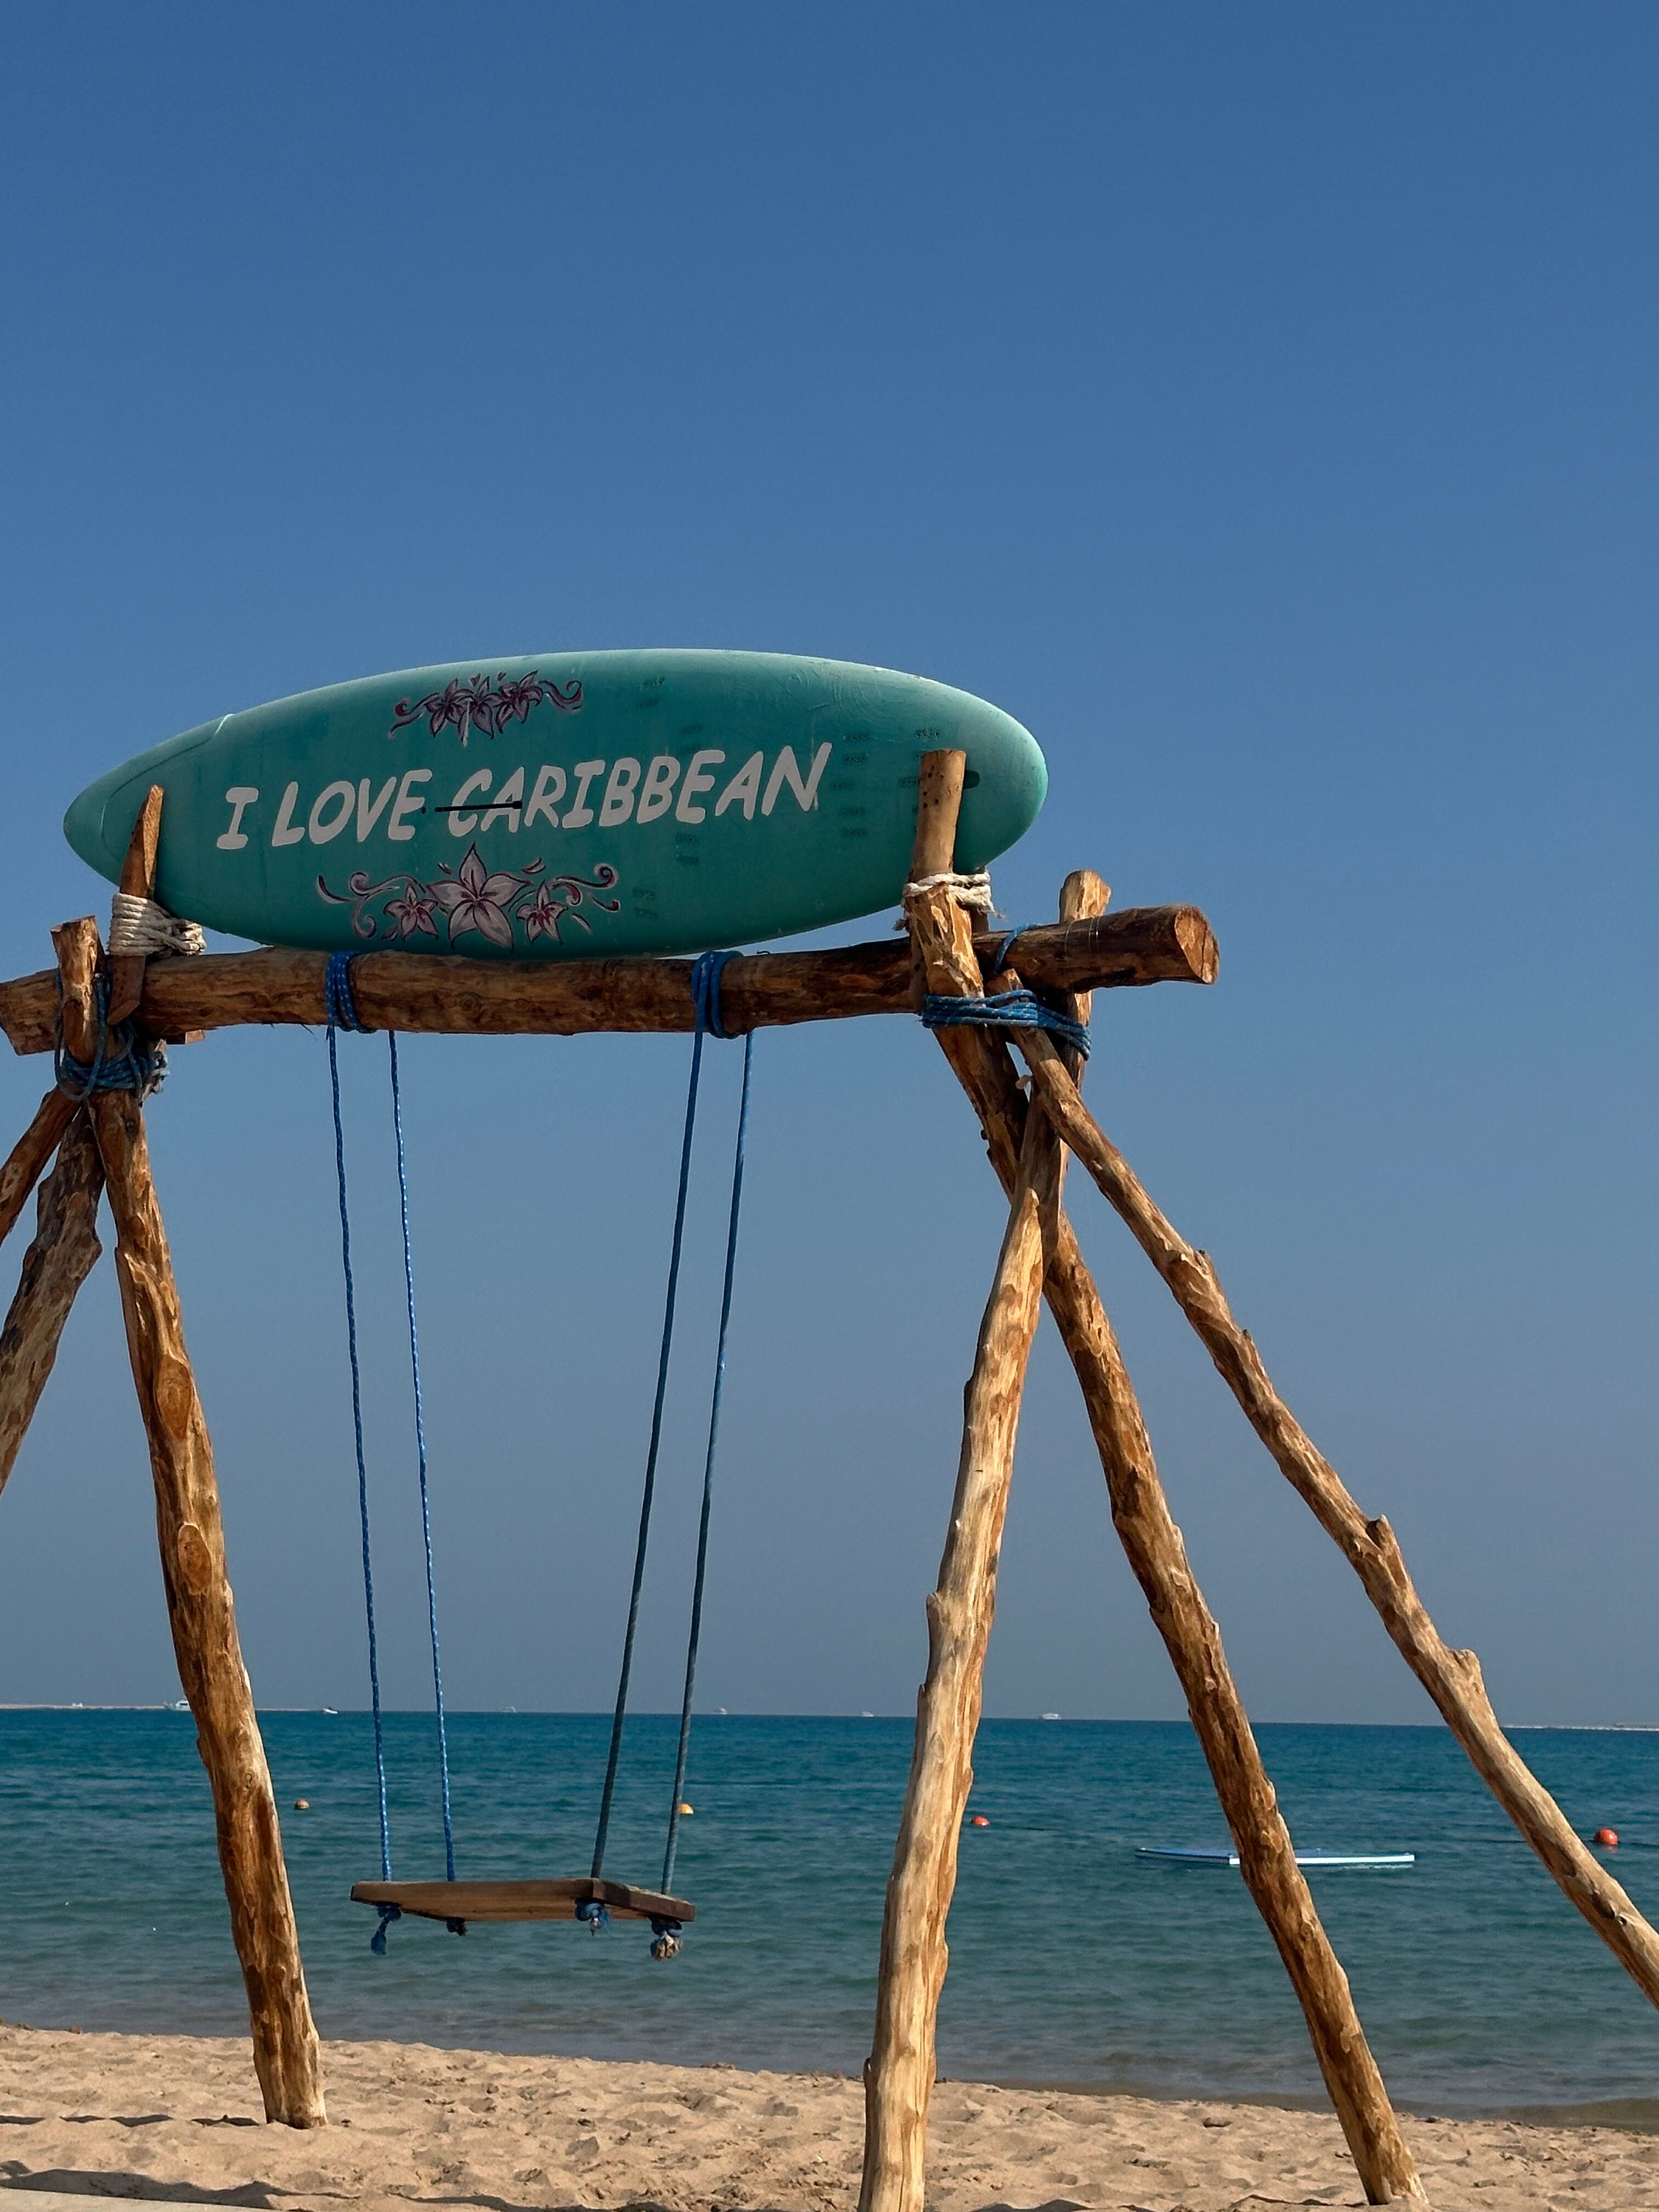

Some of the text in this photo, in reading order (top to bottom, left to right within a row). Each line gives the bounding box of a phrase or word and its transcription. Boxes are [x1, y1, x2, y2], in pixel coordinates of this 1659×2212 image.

[217, 742, 832, 850] I LOVE CARIBBEAN
